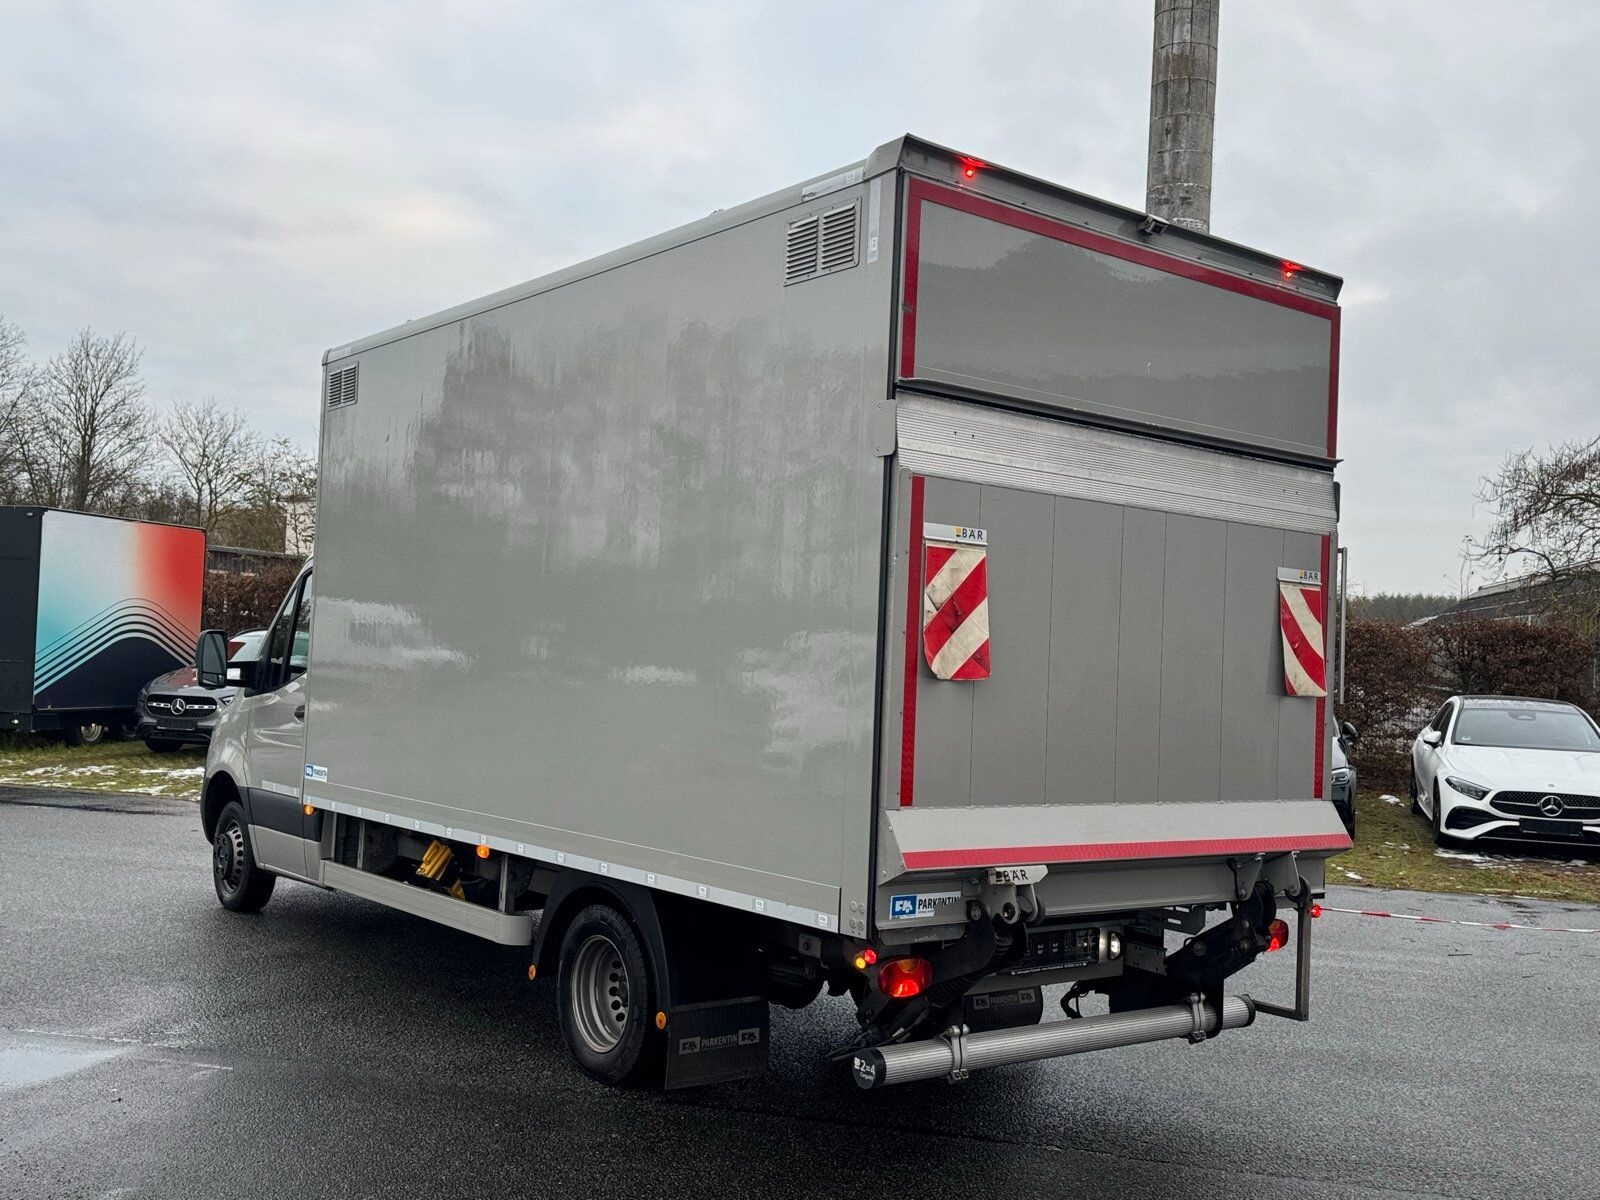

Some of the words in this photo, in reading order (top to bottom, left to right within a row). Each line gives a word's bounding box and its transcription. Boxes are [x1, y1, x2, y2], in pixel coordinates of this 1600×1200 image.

[962, 527, 983, 540] BÄR
[1003, 869, 1029, 882] BÄR
[701, 1034, 738, 1048] PARKENTIN
